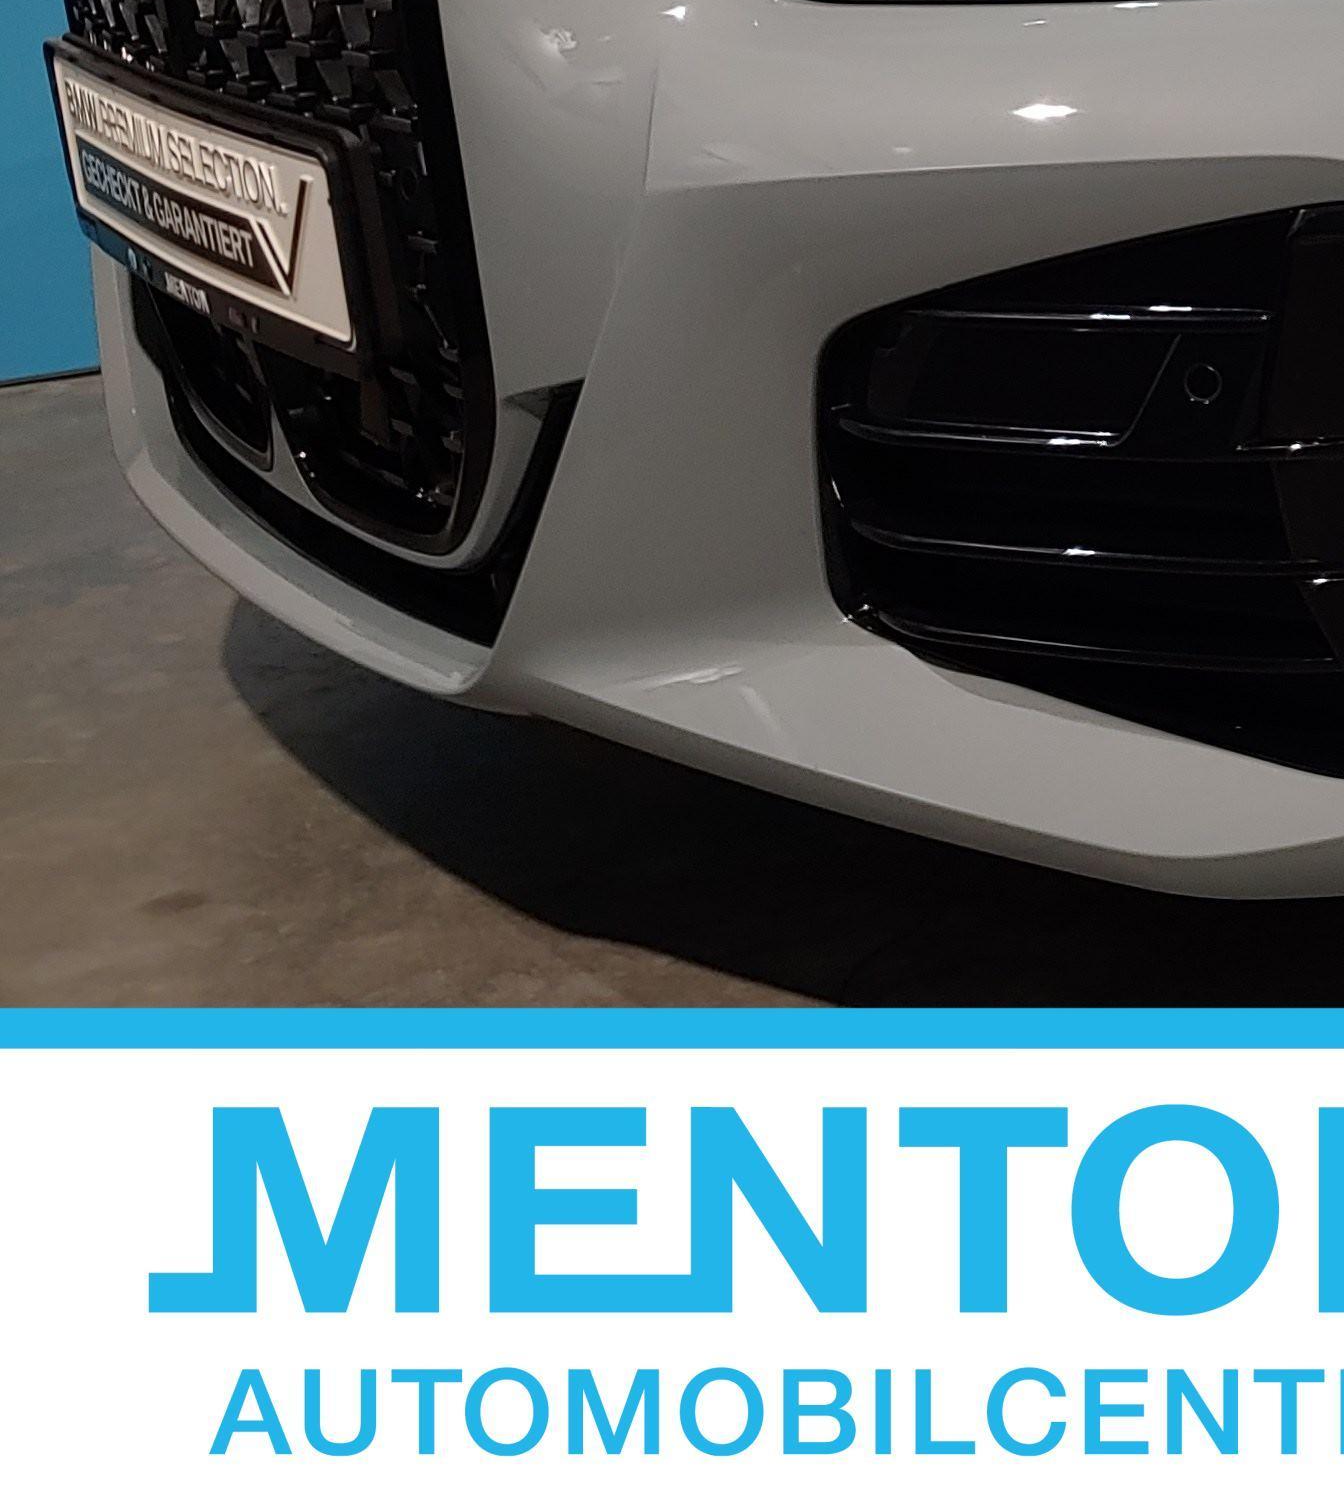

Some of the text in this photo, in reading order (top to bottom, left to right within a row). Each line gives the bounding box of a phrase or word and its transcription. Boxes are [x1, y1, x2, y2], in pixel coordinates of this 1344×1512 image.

[63, 78, 101, 133] BMW
[98, 97, 171, 170] PREMIUM
[81, 149, 143, 214] GECHECKT
[152, 191, 254, 267] GARANTIERT
